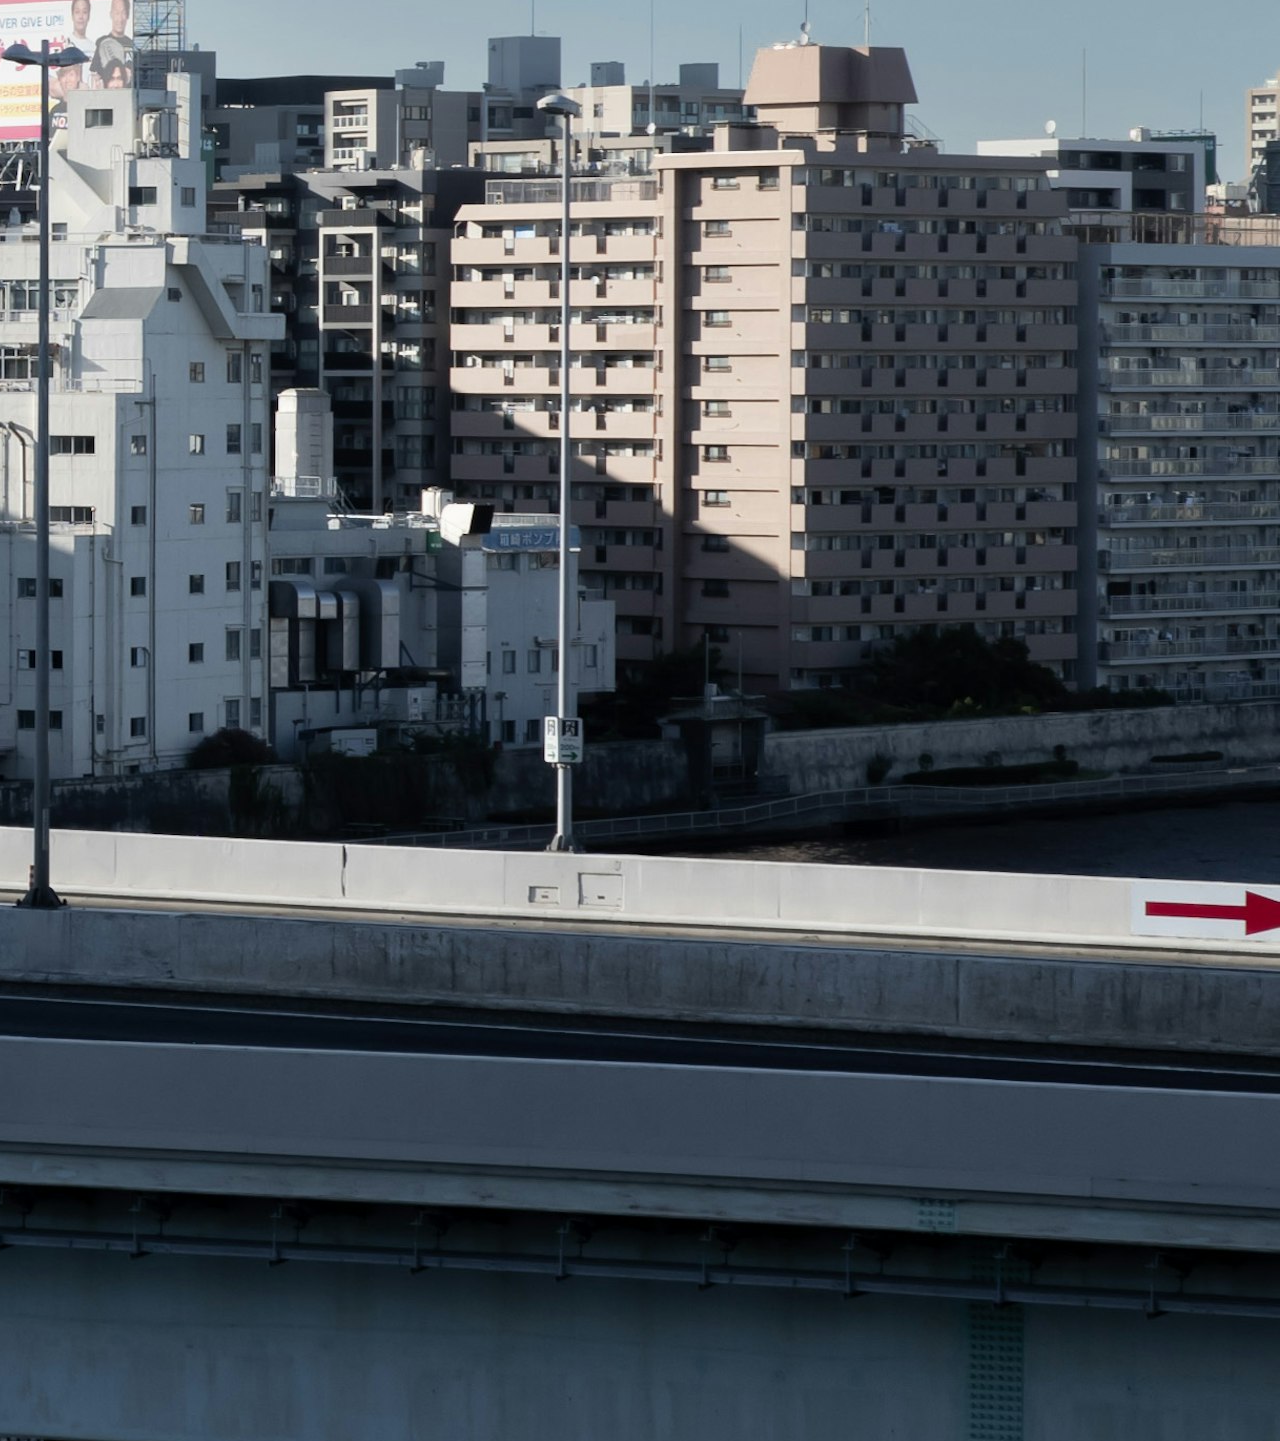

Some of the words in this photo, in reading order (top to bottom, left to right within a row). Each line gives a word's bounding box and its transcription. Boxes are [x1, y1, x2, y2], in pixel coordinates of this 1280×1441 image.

[20, 16, 43, 28] GIVE
[499, 531, 560, 547] 箱崎ポンプ
